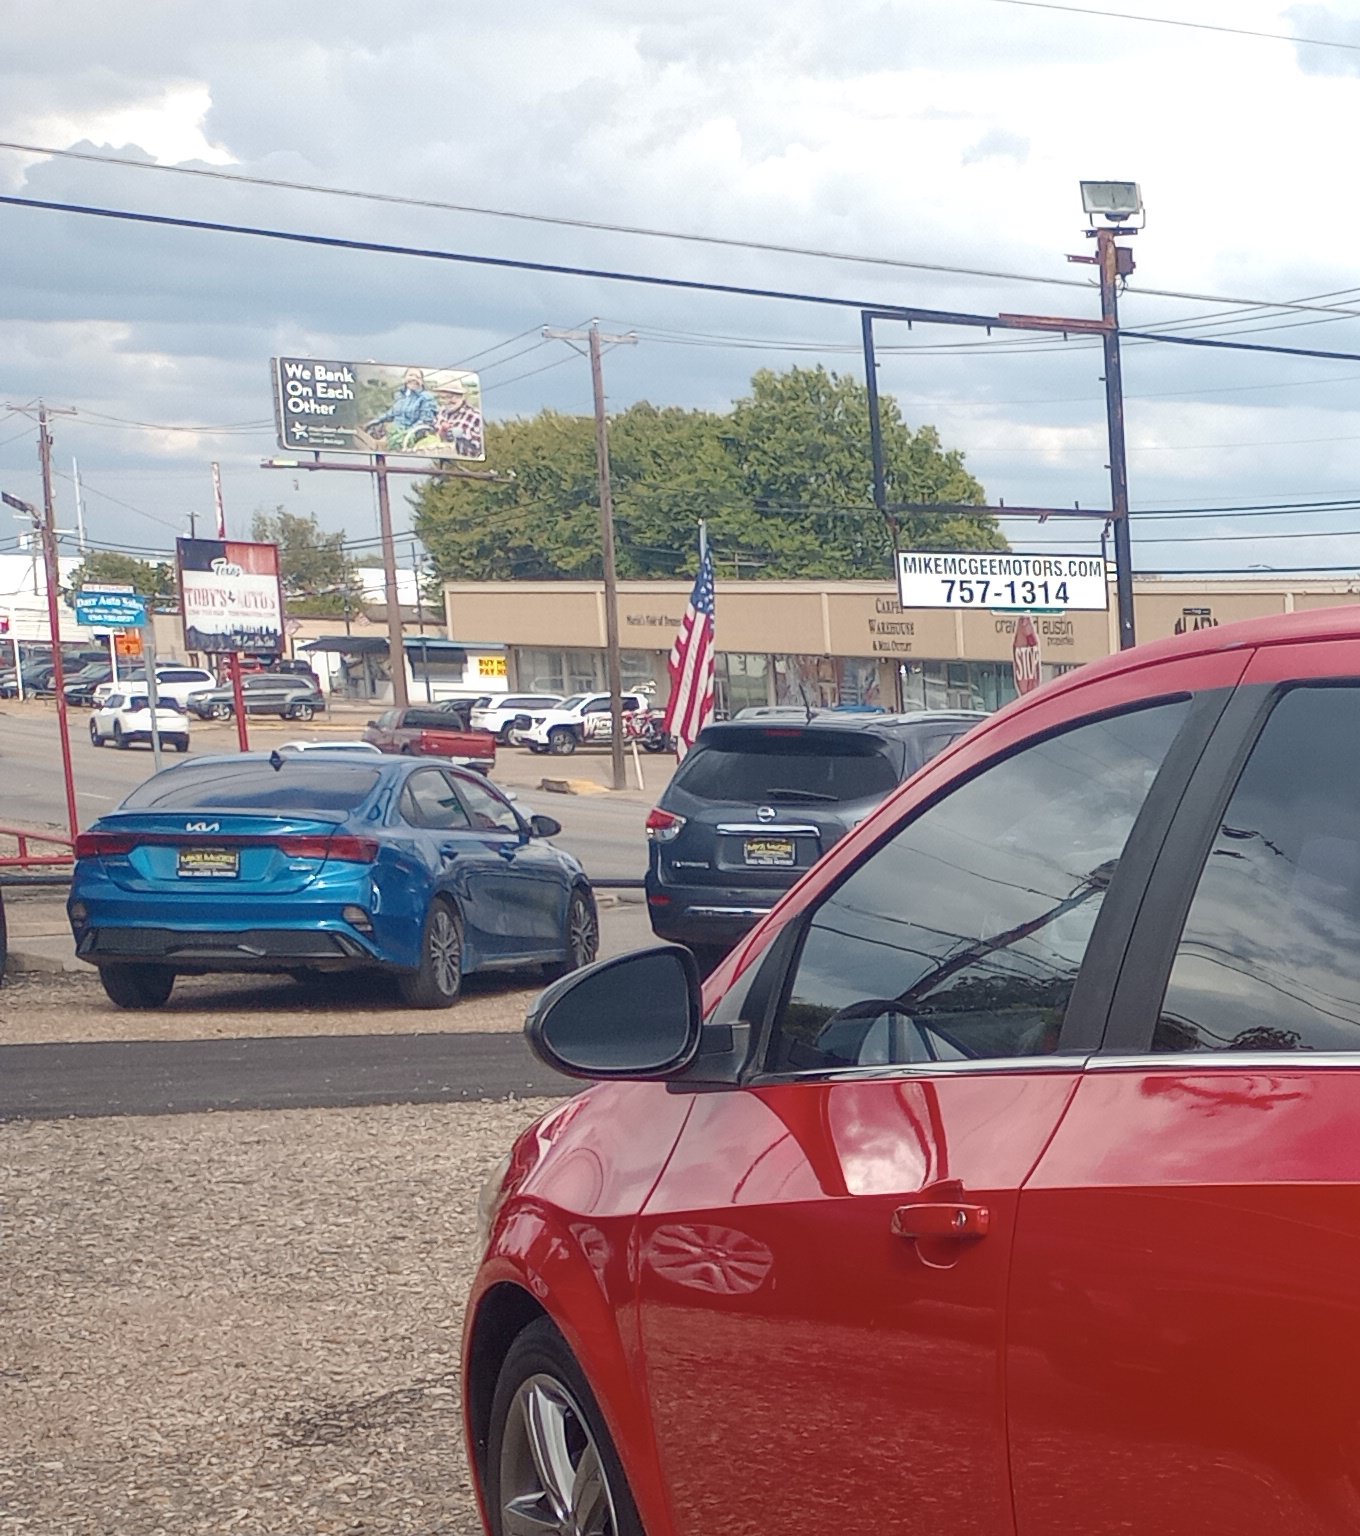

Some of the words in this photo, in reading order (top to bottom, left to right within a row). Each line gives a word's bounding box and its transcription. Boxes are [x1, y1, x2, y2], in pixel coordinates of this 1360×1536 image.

[284, 363, 311, 380] We
[314, 365, 354, 383] Bank
[286, 381, 312, 397] On
[316, 382, 354, 400] Each
[287, 398, 336, 415] Other
[903, 556, 1102, 577] MIKEMCGEEMOTORS.COM
[941, 579, 1070, 604] 757-1314
[1015, 646, 1039, 681] STOP
